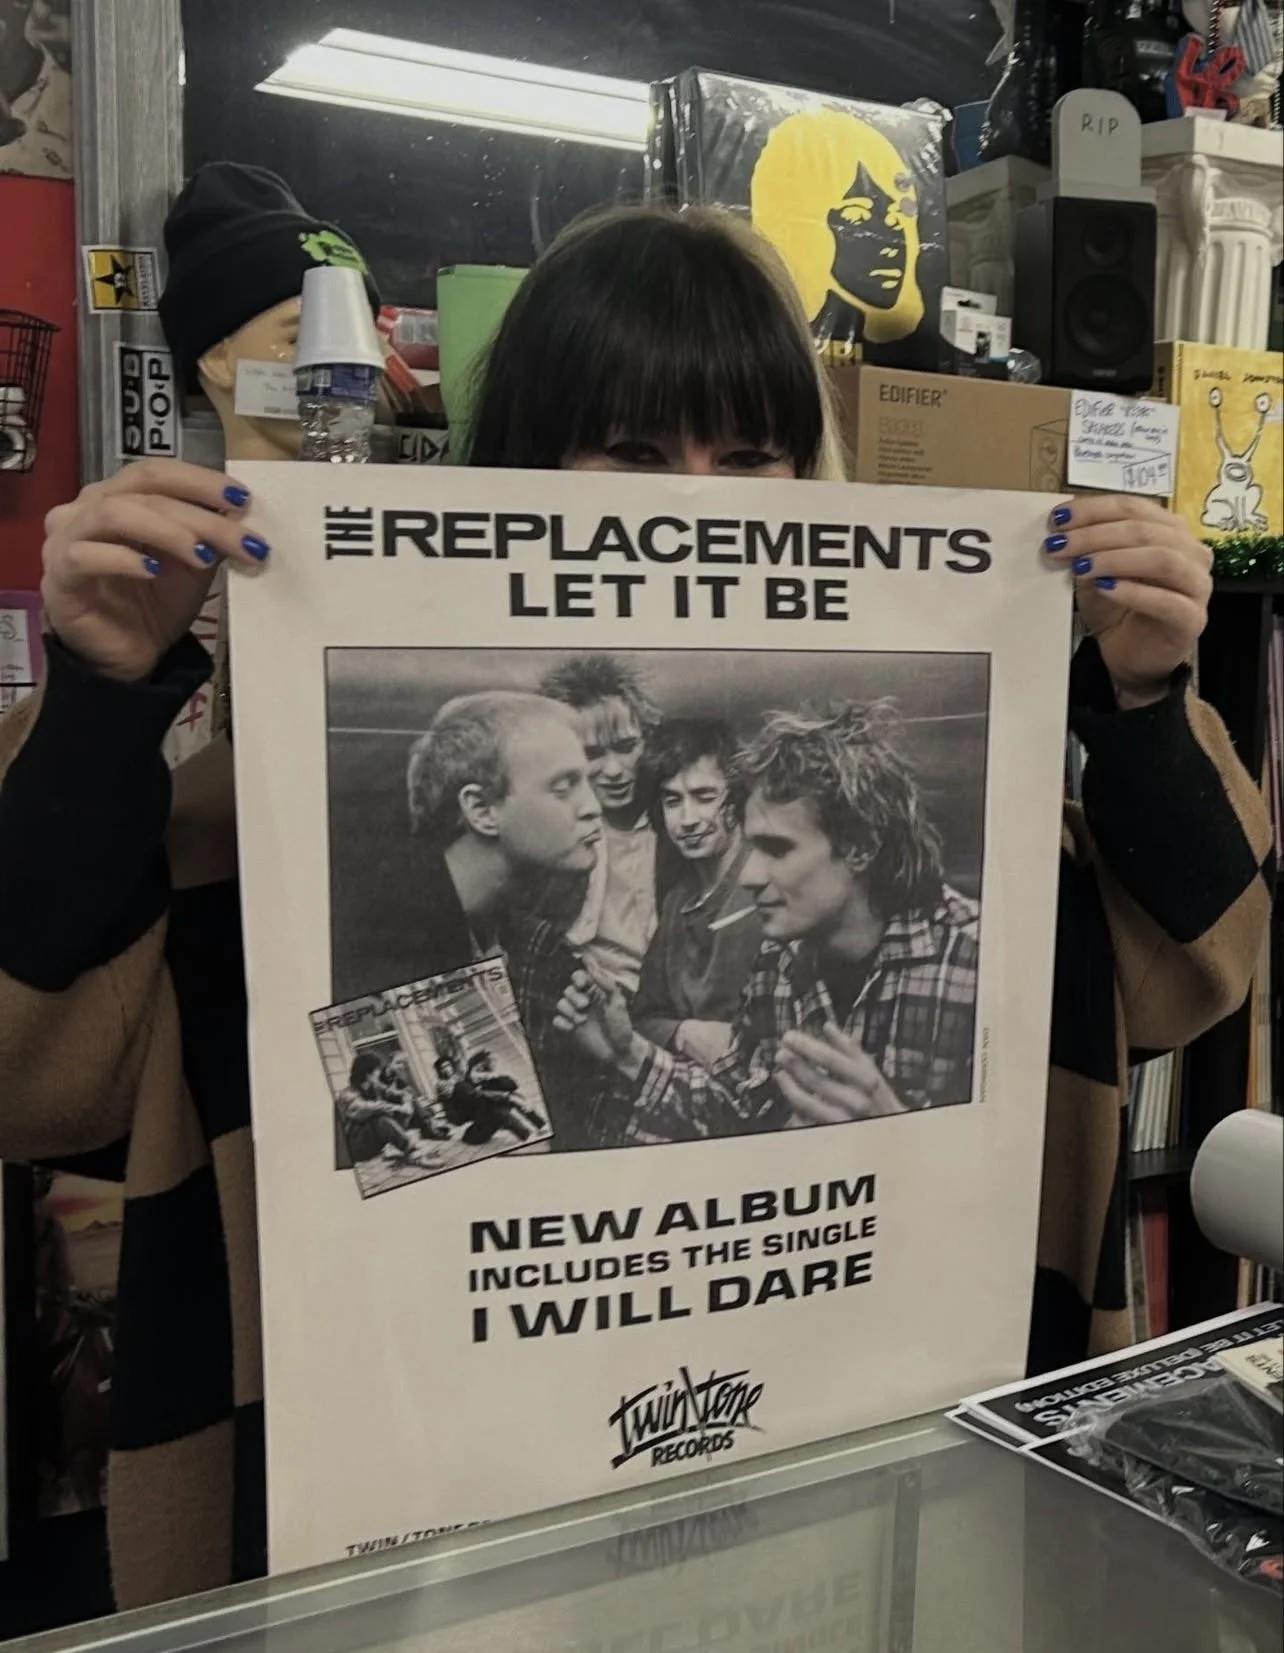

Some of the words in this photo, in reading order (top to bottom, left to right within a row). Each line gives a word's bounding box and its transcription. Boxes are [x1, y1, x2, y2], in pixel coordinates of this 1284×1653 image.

[1081, 112, 1119, 136] RIP
[879, 384, 942, 406] EDIFIER
[325, 506, 373, 560] THE
[382, 510, 992, 574] REPLACEMENTS
[509, 572, 646, 618] LET
[674, 575, 740, 619] IT
[765, 577, 849, 621] BE
[471, 1208, 642, 1254] NEW
[655, 1174, 876, 1236] ALBUM
[469, 1245, 670, 1293] INCLUDES
[682, 1238, 752, 1268] THE
[762, 1215, 877, 1257] SINGLE
[473, 1307, 488, 1343] I
[509, 1286, 691, 1339] WILL
[708, 1251, 873, 1313] DARE
[1032, 1353, 1228, 1428] ACEMENTS
[651, 1430, 735, 1468] RECORDS
